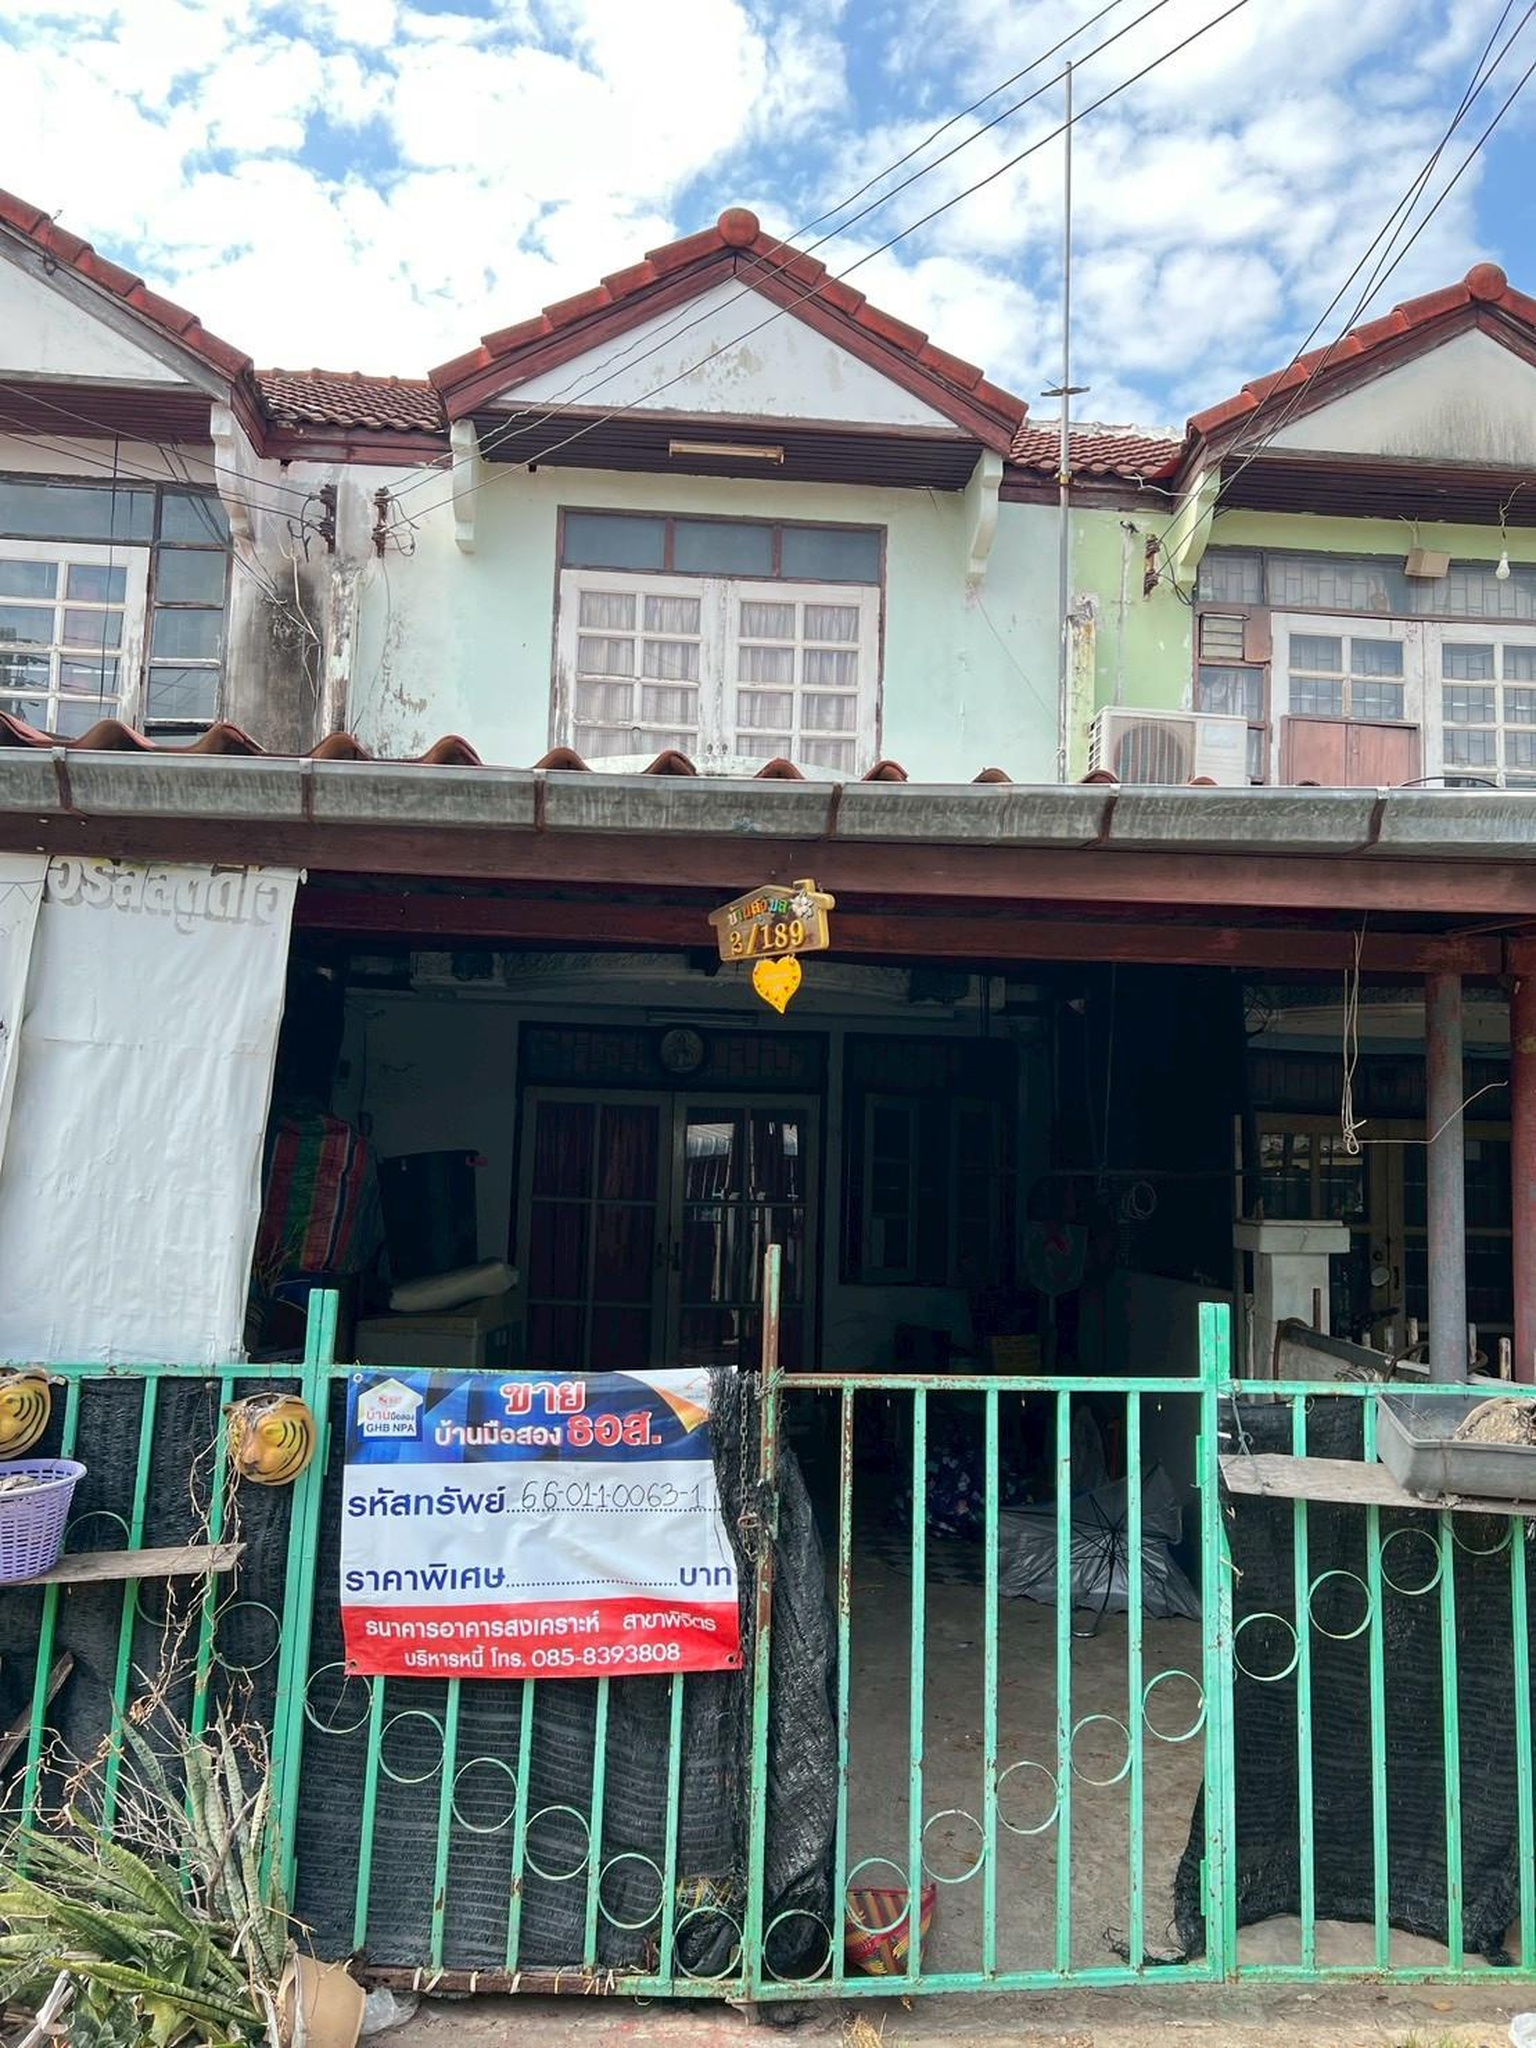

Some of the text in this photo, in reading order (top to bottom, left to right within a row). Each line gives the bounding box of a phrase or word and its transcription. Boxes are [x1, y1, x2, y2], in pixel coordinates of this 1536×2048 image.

[730, 920, 804, 955] 2/189
[500, 1380, 586, 1415] ขาย
[366, 1423, 415, 1433] GHB NPA
[434, 1411, 662, 1448] บ้านมือสอง ธอส.
[347, 1486, 508, 1518] รหัสทรัพย์
[345, 1564, 733, 1592] ราคาพิเศษ บาท
[365, 1610, 717, 1638] ธนาคารอาคารสงเคราะห์ สาขาพิจิตร
[404, 1644, 681, 1668] บริหารหนี้ โทร. 085-8393808
